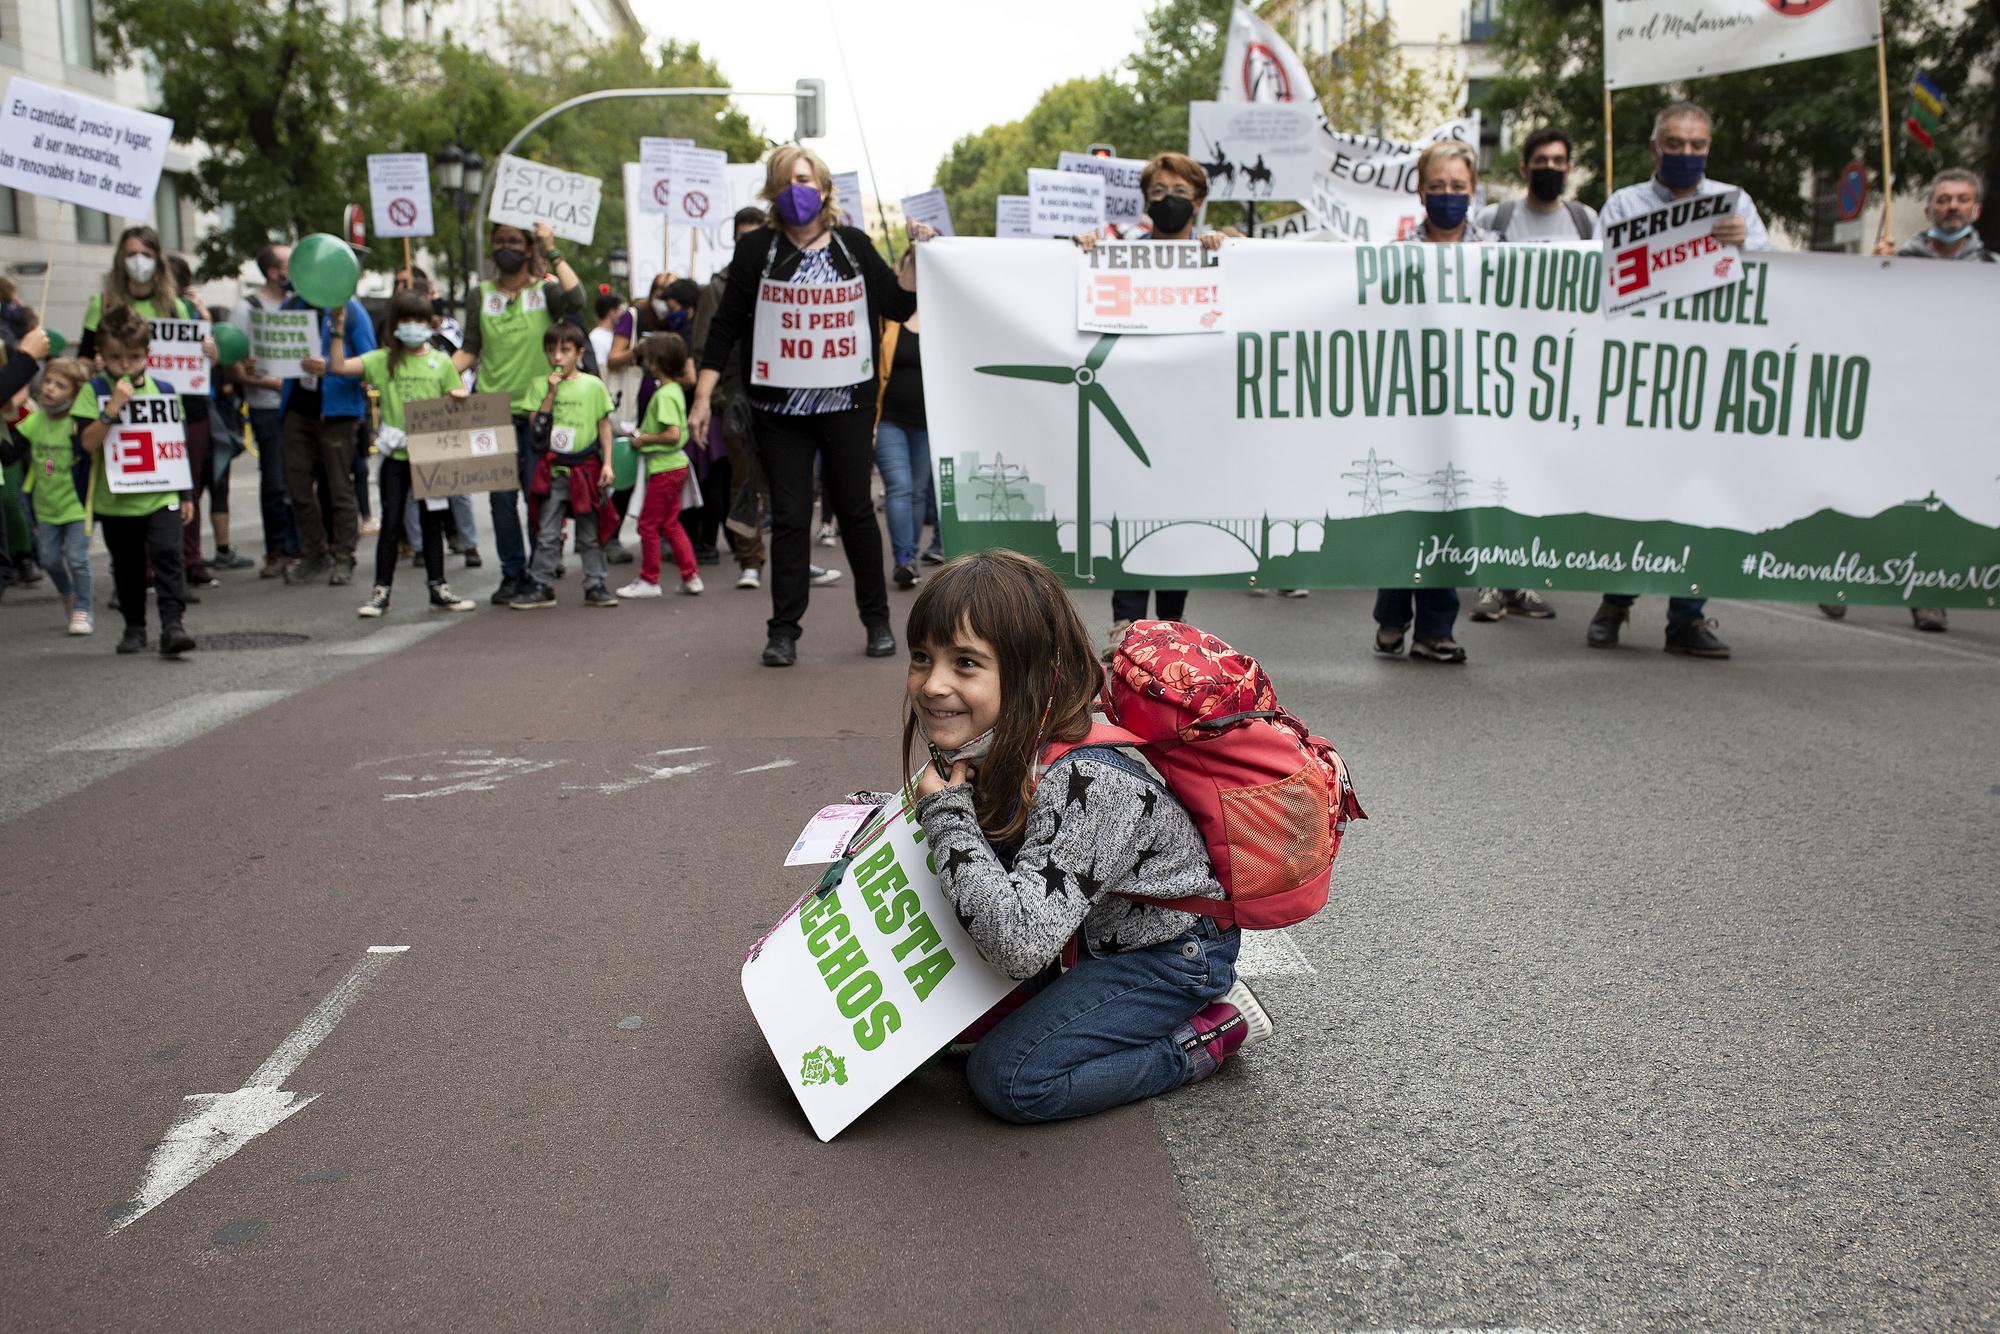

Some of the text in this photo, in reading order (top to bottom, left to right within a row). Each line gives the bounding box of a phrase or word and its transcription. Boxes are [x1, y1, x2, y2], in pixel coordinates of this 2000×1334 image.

[12, 99, 27, 117] En
[80, 119, 113, 140] precio
[114, 128, 123, 145] y
[124, 128, 153, 151] lugar,
[33, 133, 122, 172] al ser necesarias,
[17, 157, 75, 183] renovables
[79, 168, 97, 187] han
[100, 175, 113, 192] de
[115, 181, 143, 199] estar.
[1331, 152, 1419, 195] EÓLIC
[501, 188, 592, 227] EÓLICAS
[1607, 194, 1731, 249] TERUEL
[1090, 245, 1219, 269] TERUEL
[762, 282, 864, 306] RENOVABLES
[1355, 244, 1426, 305] POR
[1436, 244, 1472, 304] EL
[1480, 246, 1602, 315] FUTURO
[147, 322, 204, 342] RUEL
[781, 308, 855, 330] SÍ PERO
[780, 331, 856, 359] NO ASÍ
[1236, 328, 1870, 440] RENOVABLES SÍ, PERO ASÍ NO
[1416, 534, 1691, 576] ¡Hagamos las cosas bien!
[829, 842, 844, 860] 500
[853, 841, 957, 1004] RESTA
